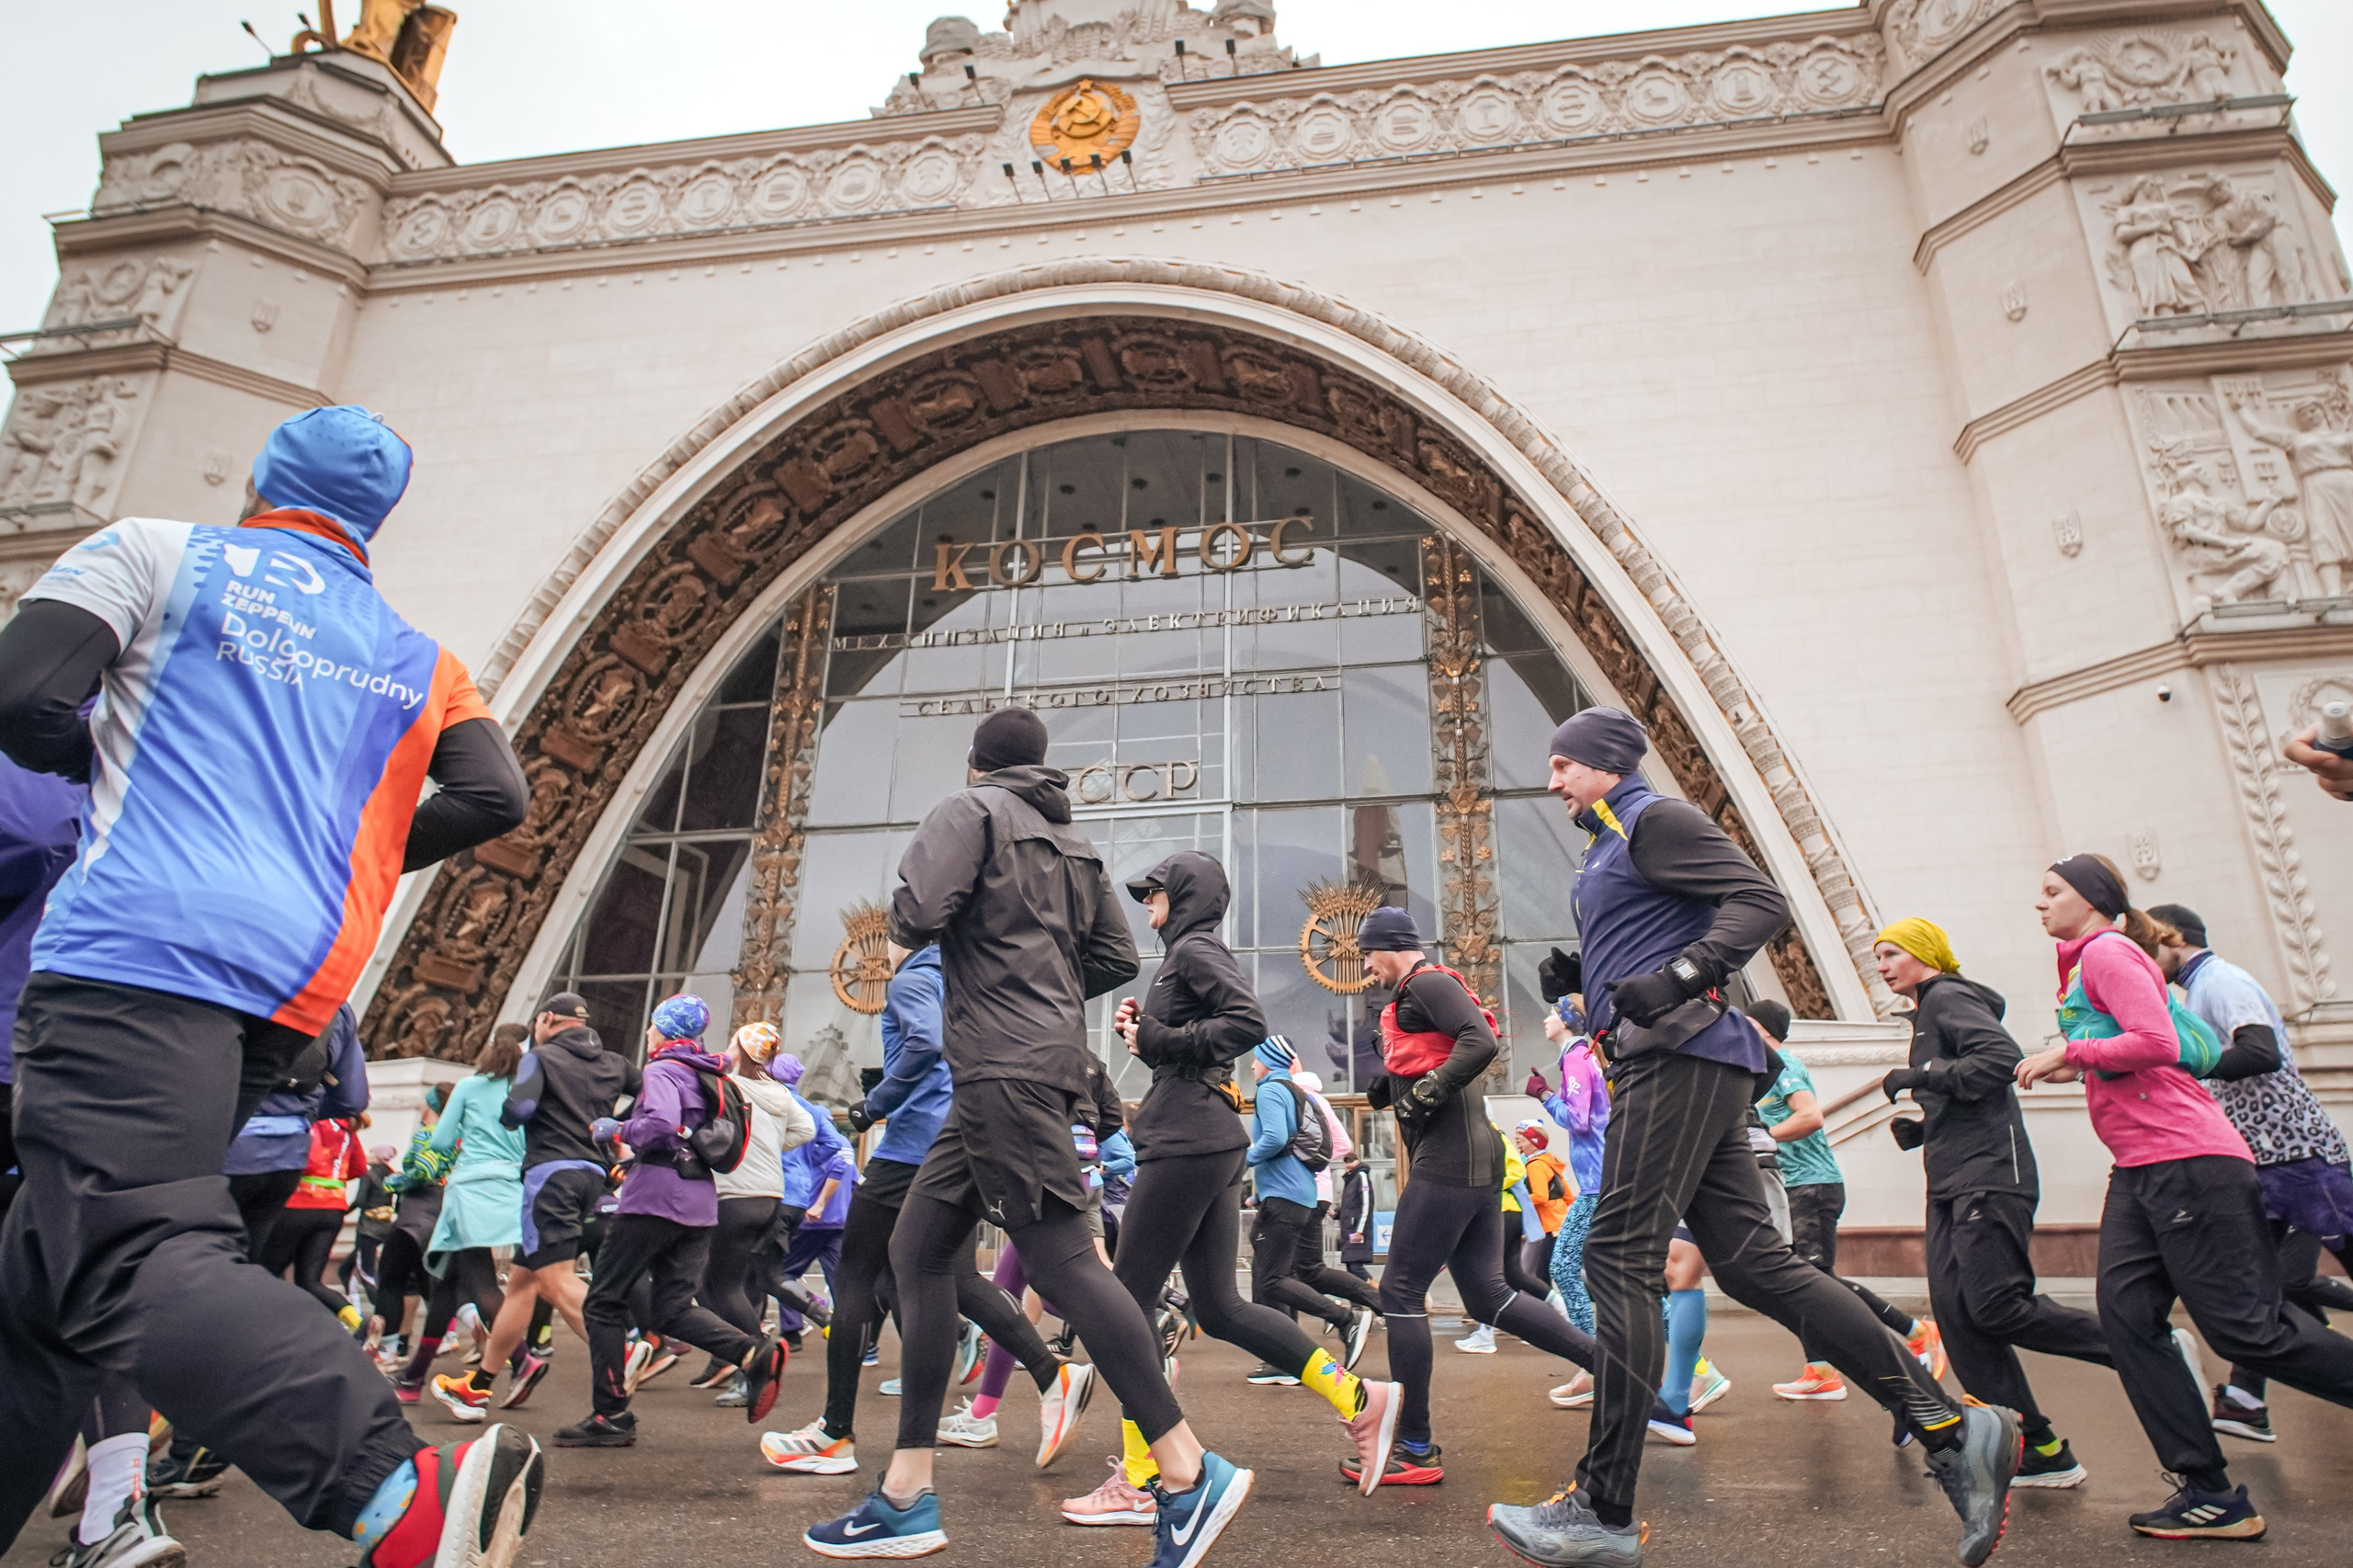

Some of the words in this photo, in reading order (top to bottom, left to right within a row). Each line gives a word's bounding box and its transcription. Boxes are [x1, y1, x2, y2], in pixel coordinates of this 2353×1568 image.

[930, 516, 1315, 592] КОСМОС
[225, 579, 277, 605] RUN
[833, 620, 1065, 650] МЕХАНИЗАЦИЯ
[1102, 595, 1418, 633] ЭЛЕКТРИФИКАЦИЯ
[215, 641, 304, 692] RUSSIA
[221, 611, 425, 711] Dolgoprudny
[1074, 759, 1199, 804] ССР
